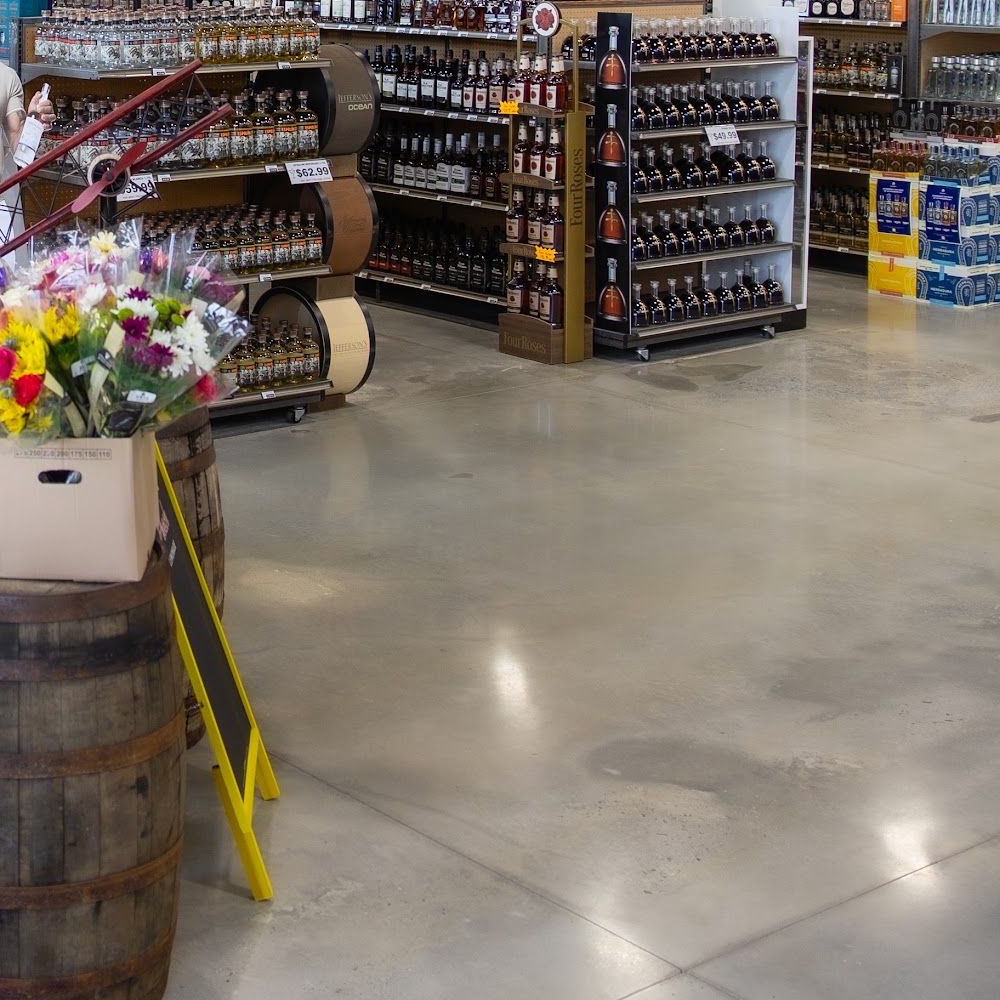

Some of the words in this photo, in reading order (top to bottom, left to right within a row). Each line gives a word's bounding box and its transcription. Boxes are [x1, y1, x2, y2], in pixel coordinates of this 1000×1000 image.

[338, 92, 372, 103] JEFFERSON'S
[713, 132, 737, 140] $49.99
[296, 167, 329, 177] $62.99
